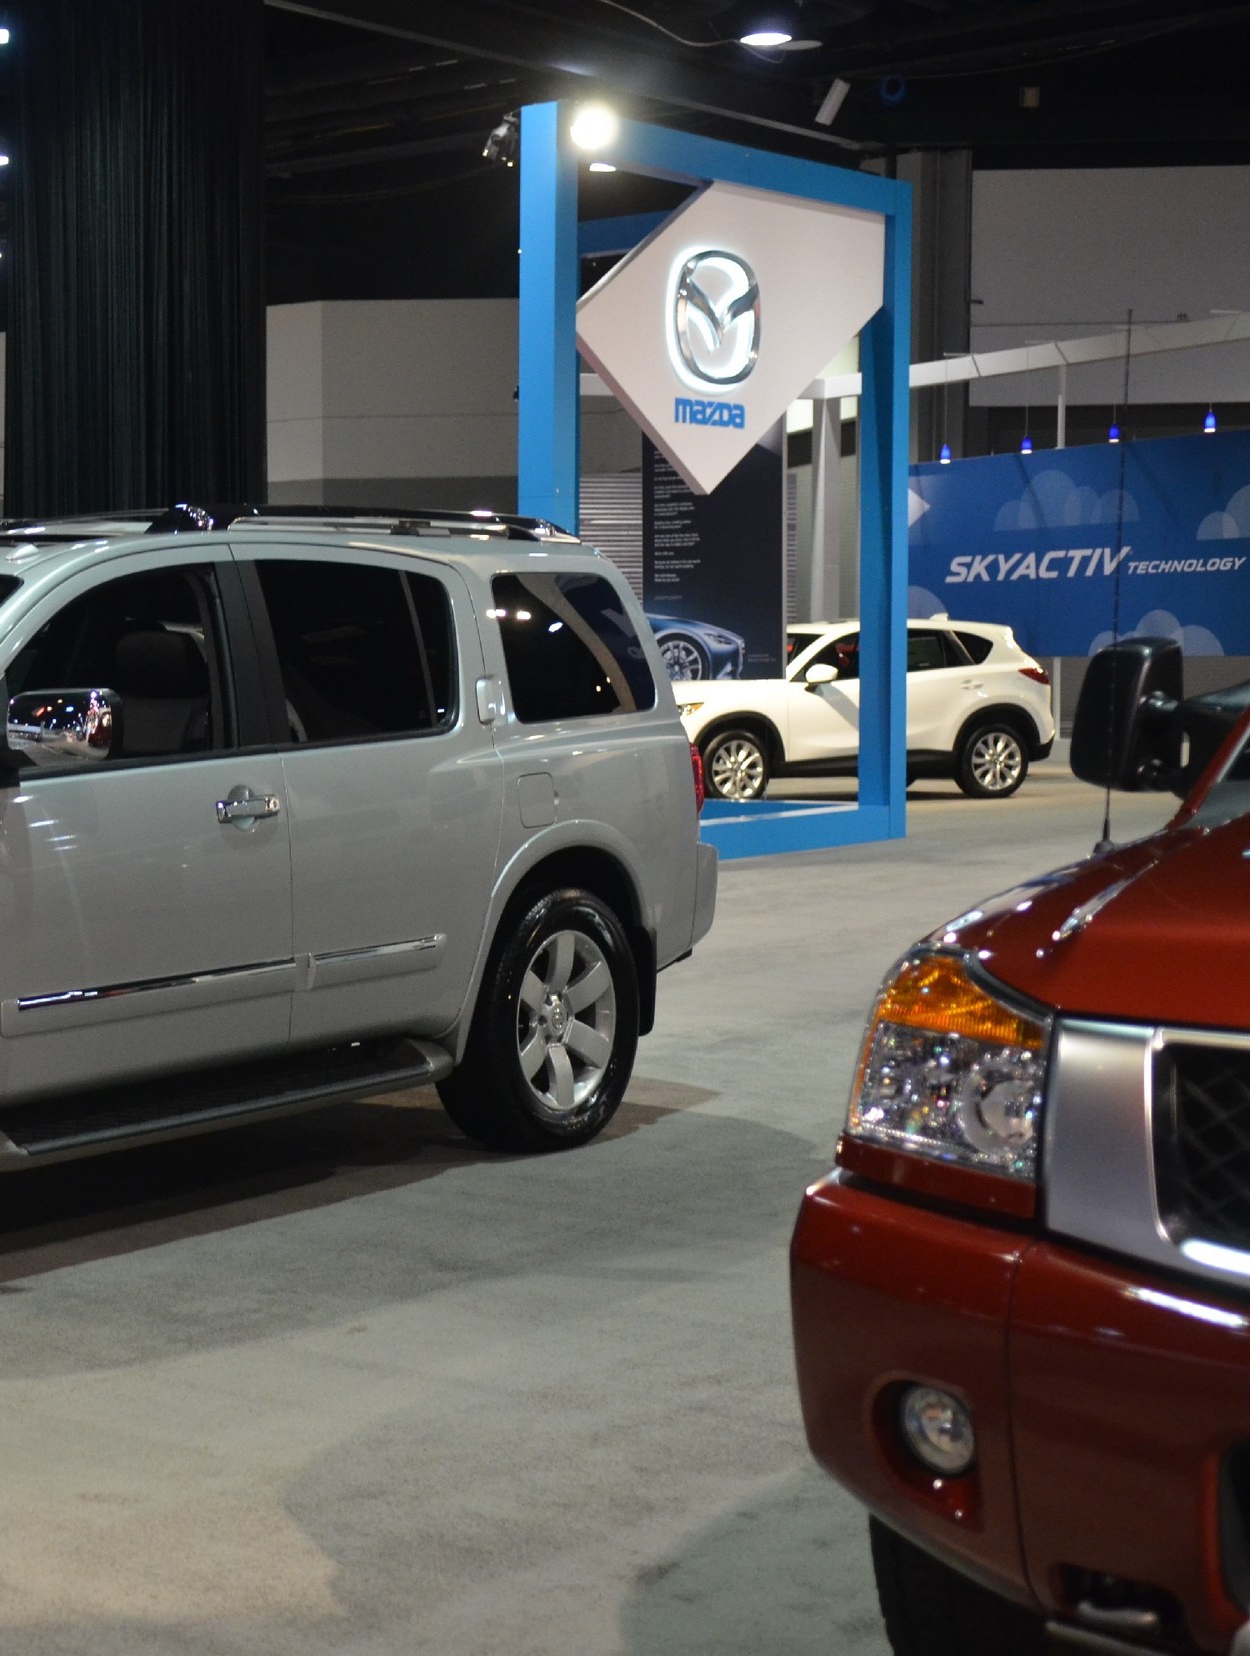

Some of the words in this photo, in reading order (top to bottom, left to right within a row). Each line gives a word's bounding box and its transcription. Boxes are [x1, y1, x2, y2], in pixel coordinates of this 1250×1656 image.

[675, 397, 745, 429] mazda
[944, 546, 1131, 584] SKYACTIV
[1128, 557, 1247, 575] TECHNOLOGY
